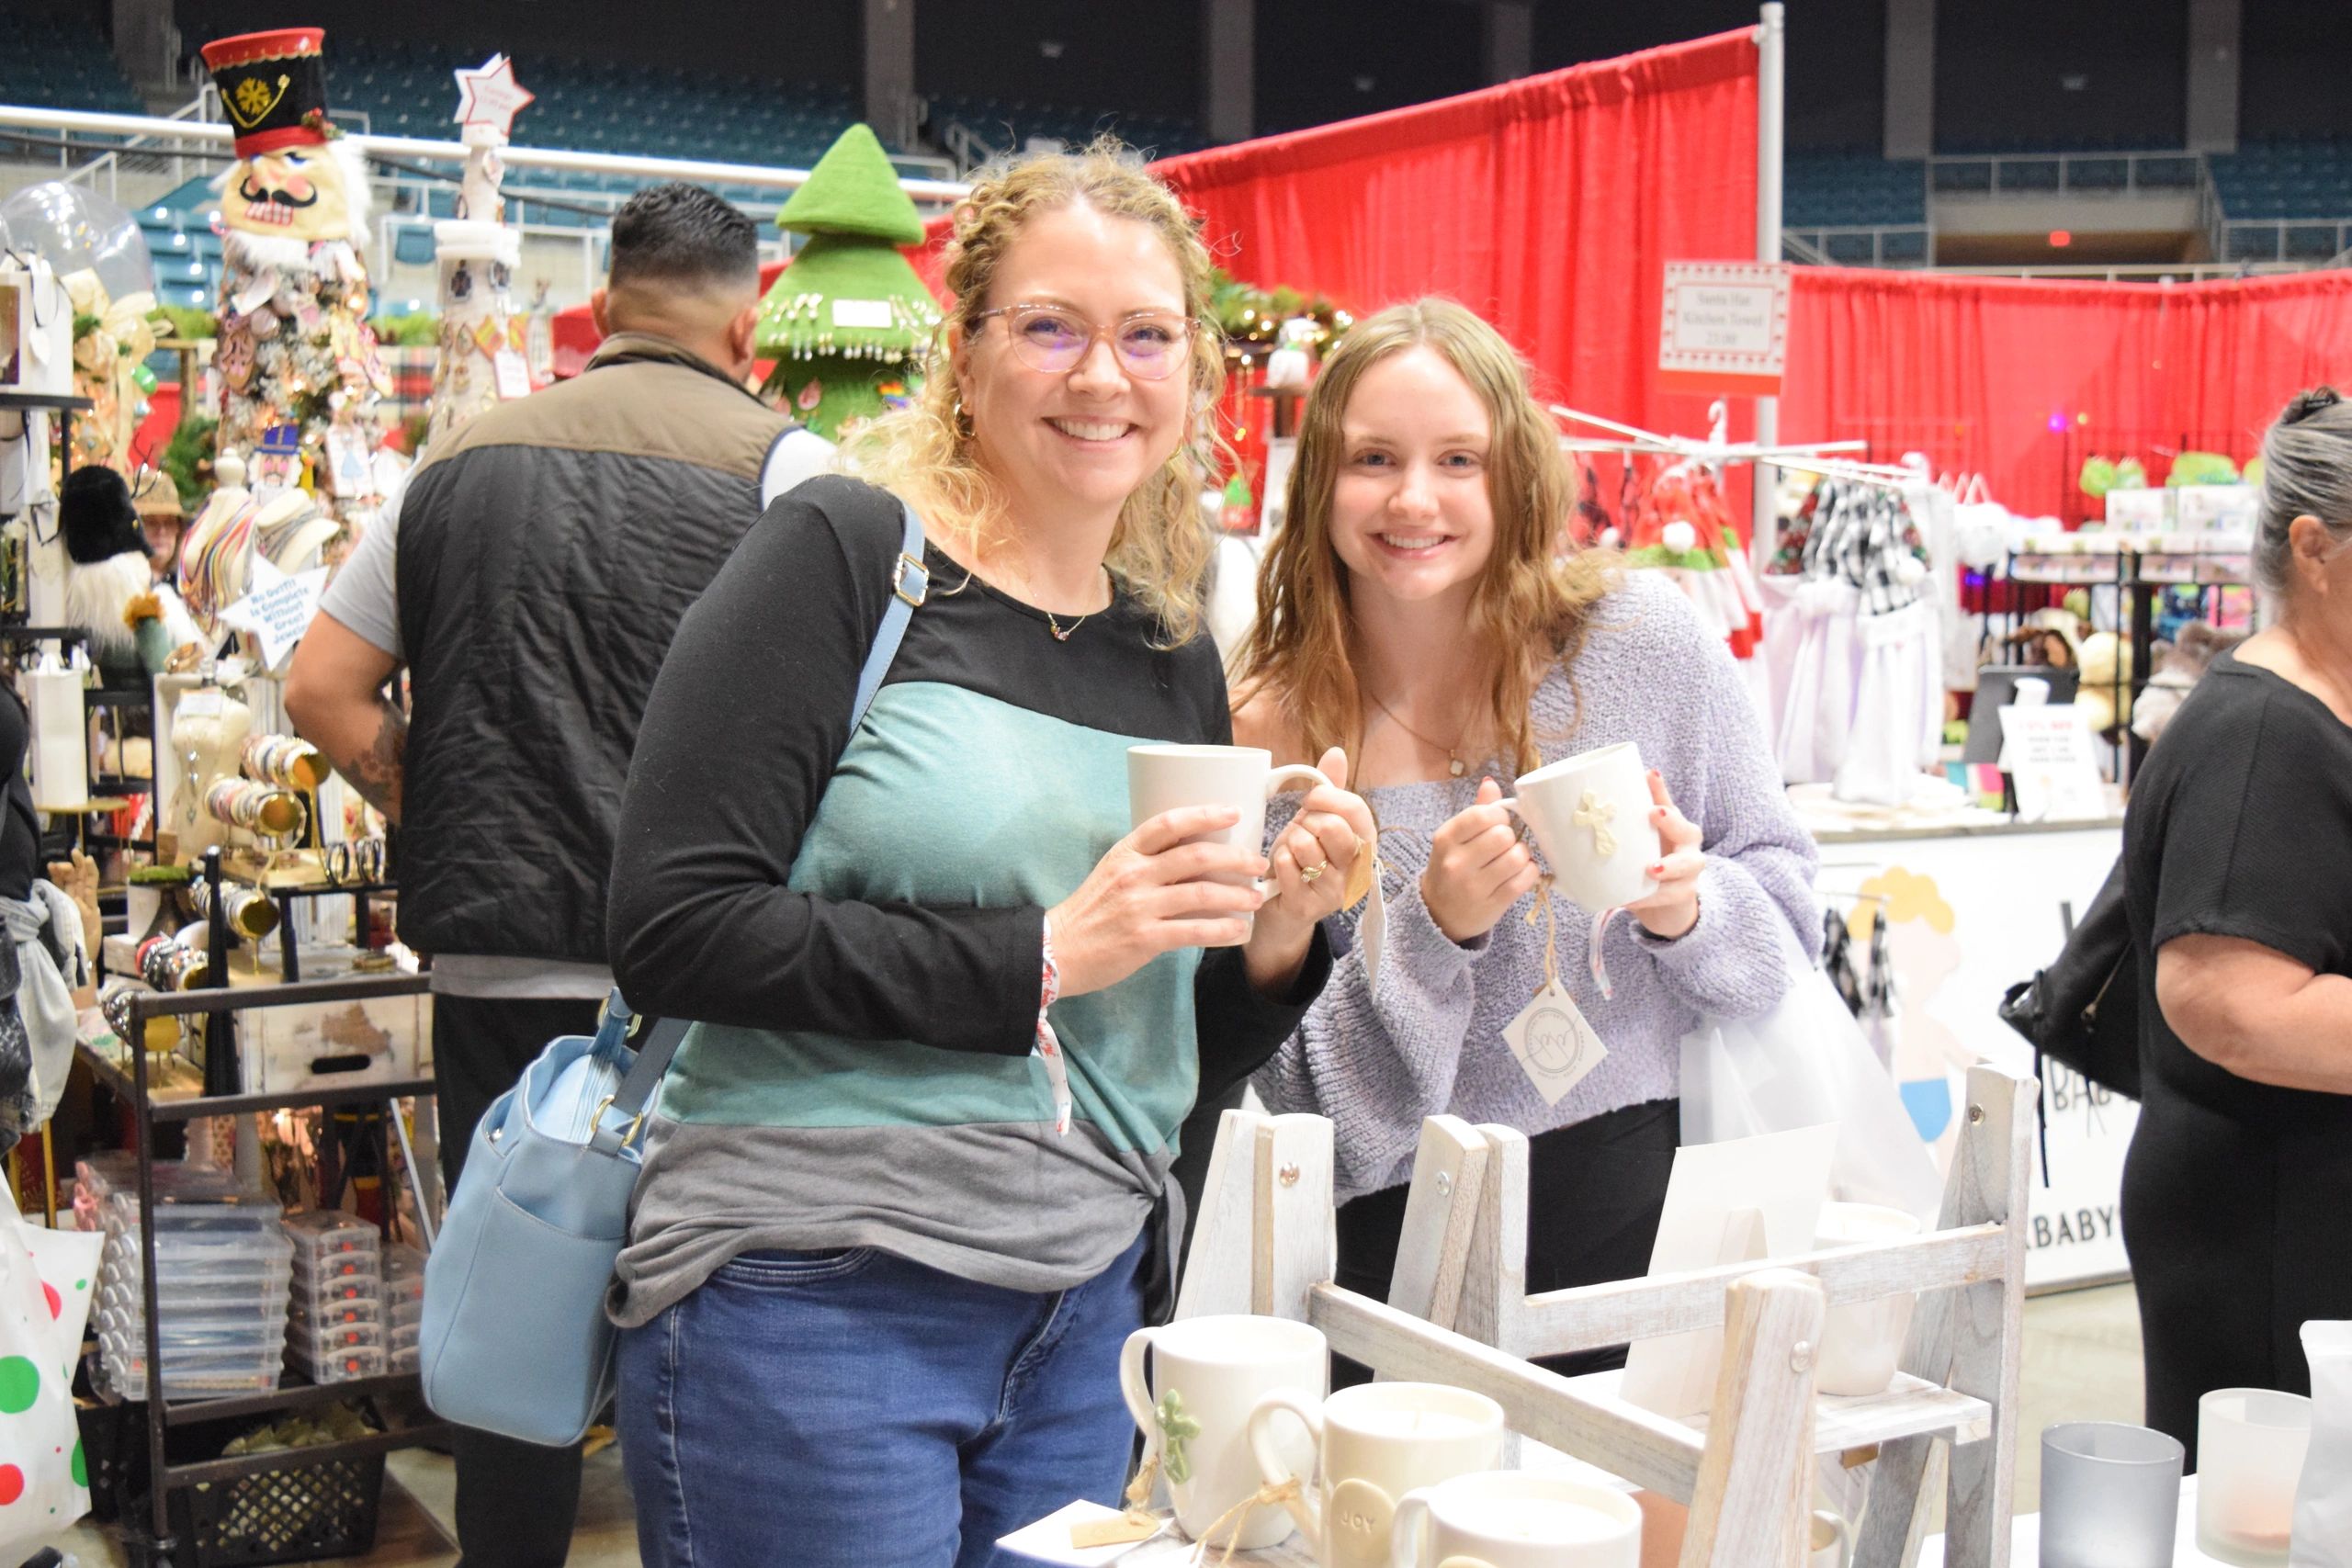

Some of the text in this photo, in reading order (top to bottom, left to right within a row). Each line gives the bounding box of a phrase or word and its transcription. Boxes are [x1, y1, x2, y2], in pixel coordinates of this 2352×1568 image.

[251, 578, 296, 604] No Outfit
[261, 586, 309, 611] Complete
[263, 601, 304, 623] Without
[274, 612, 304, 631] Great
[2025, 1205, 2114, 1251] BABY
[1341, 1510, 1376, 1535] JOY
